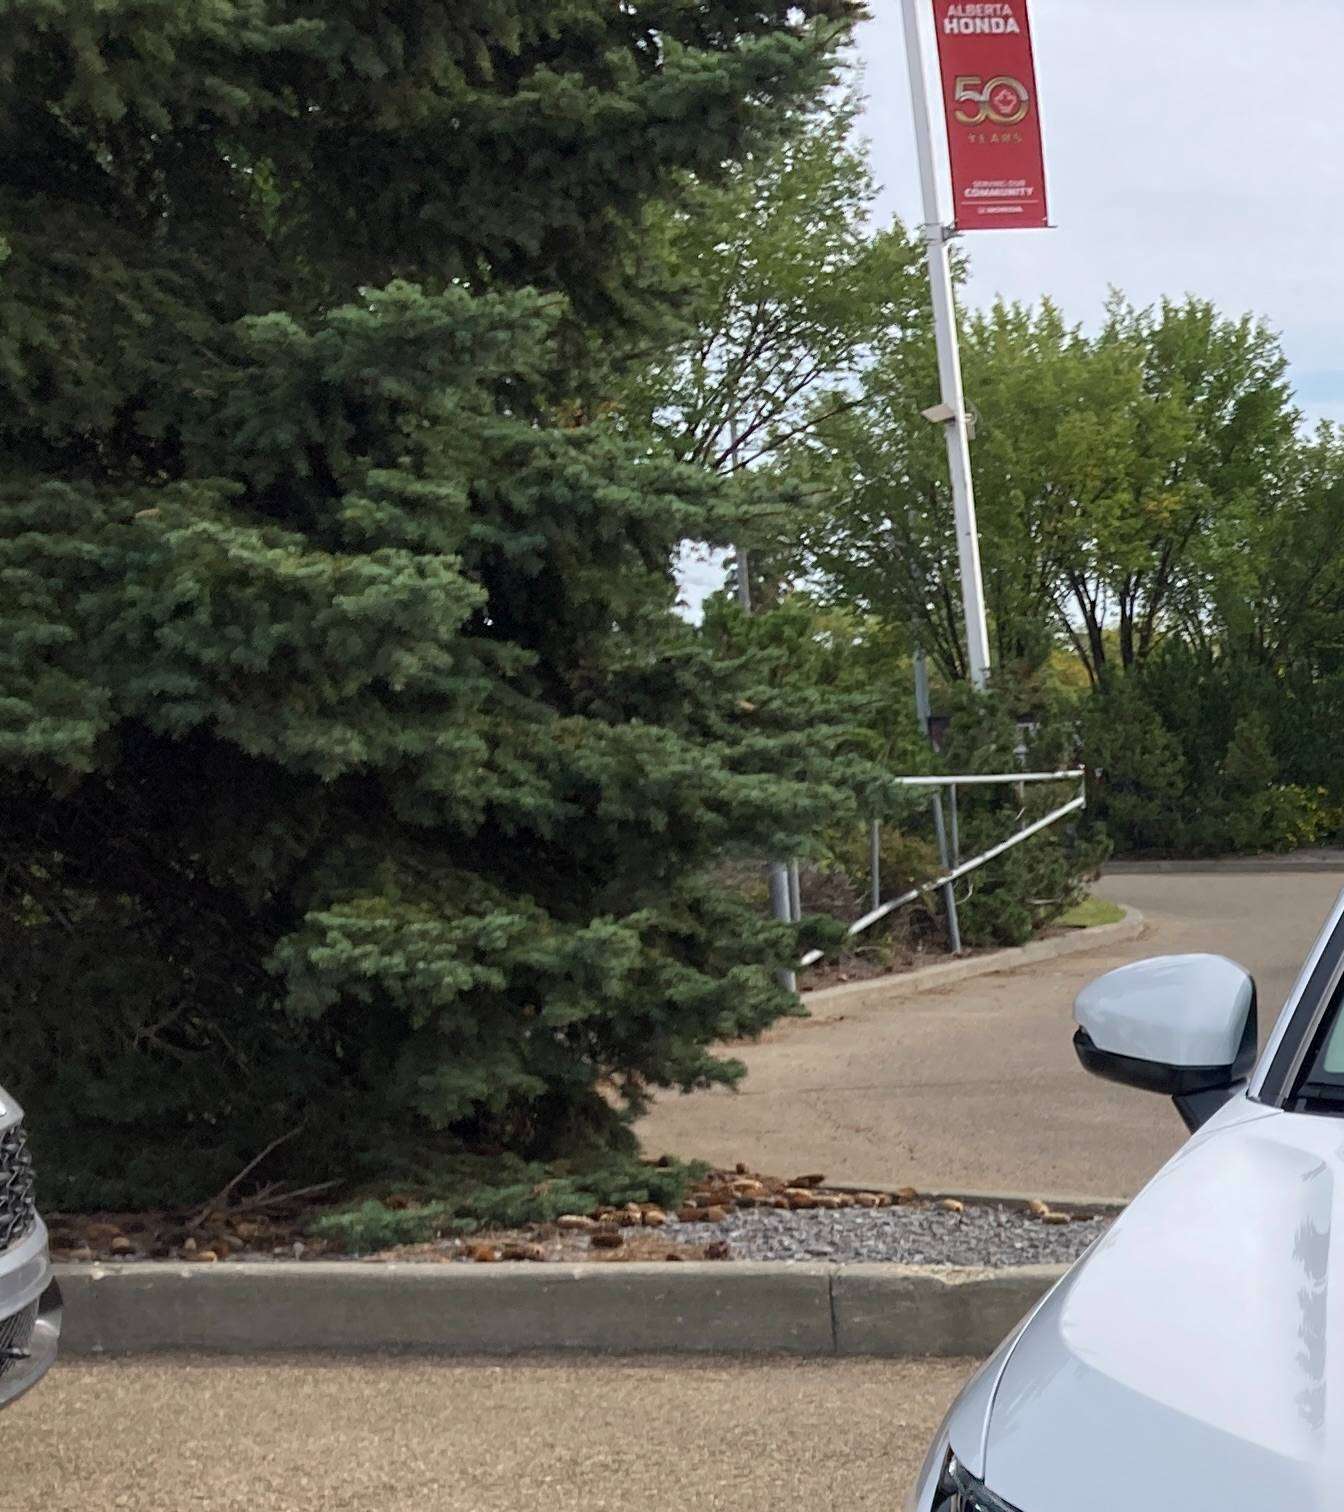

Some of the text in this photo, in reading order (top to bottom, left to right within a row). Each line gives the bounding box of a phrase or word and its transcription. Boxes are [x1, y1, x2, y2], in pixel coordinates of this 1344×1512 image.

[947, 3, 1013, 17] ALBERTA
[943, 17, 1020, 34] HONDA
[954, 75, 1029, 126] 50
